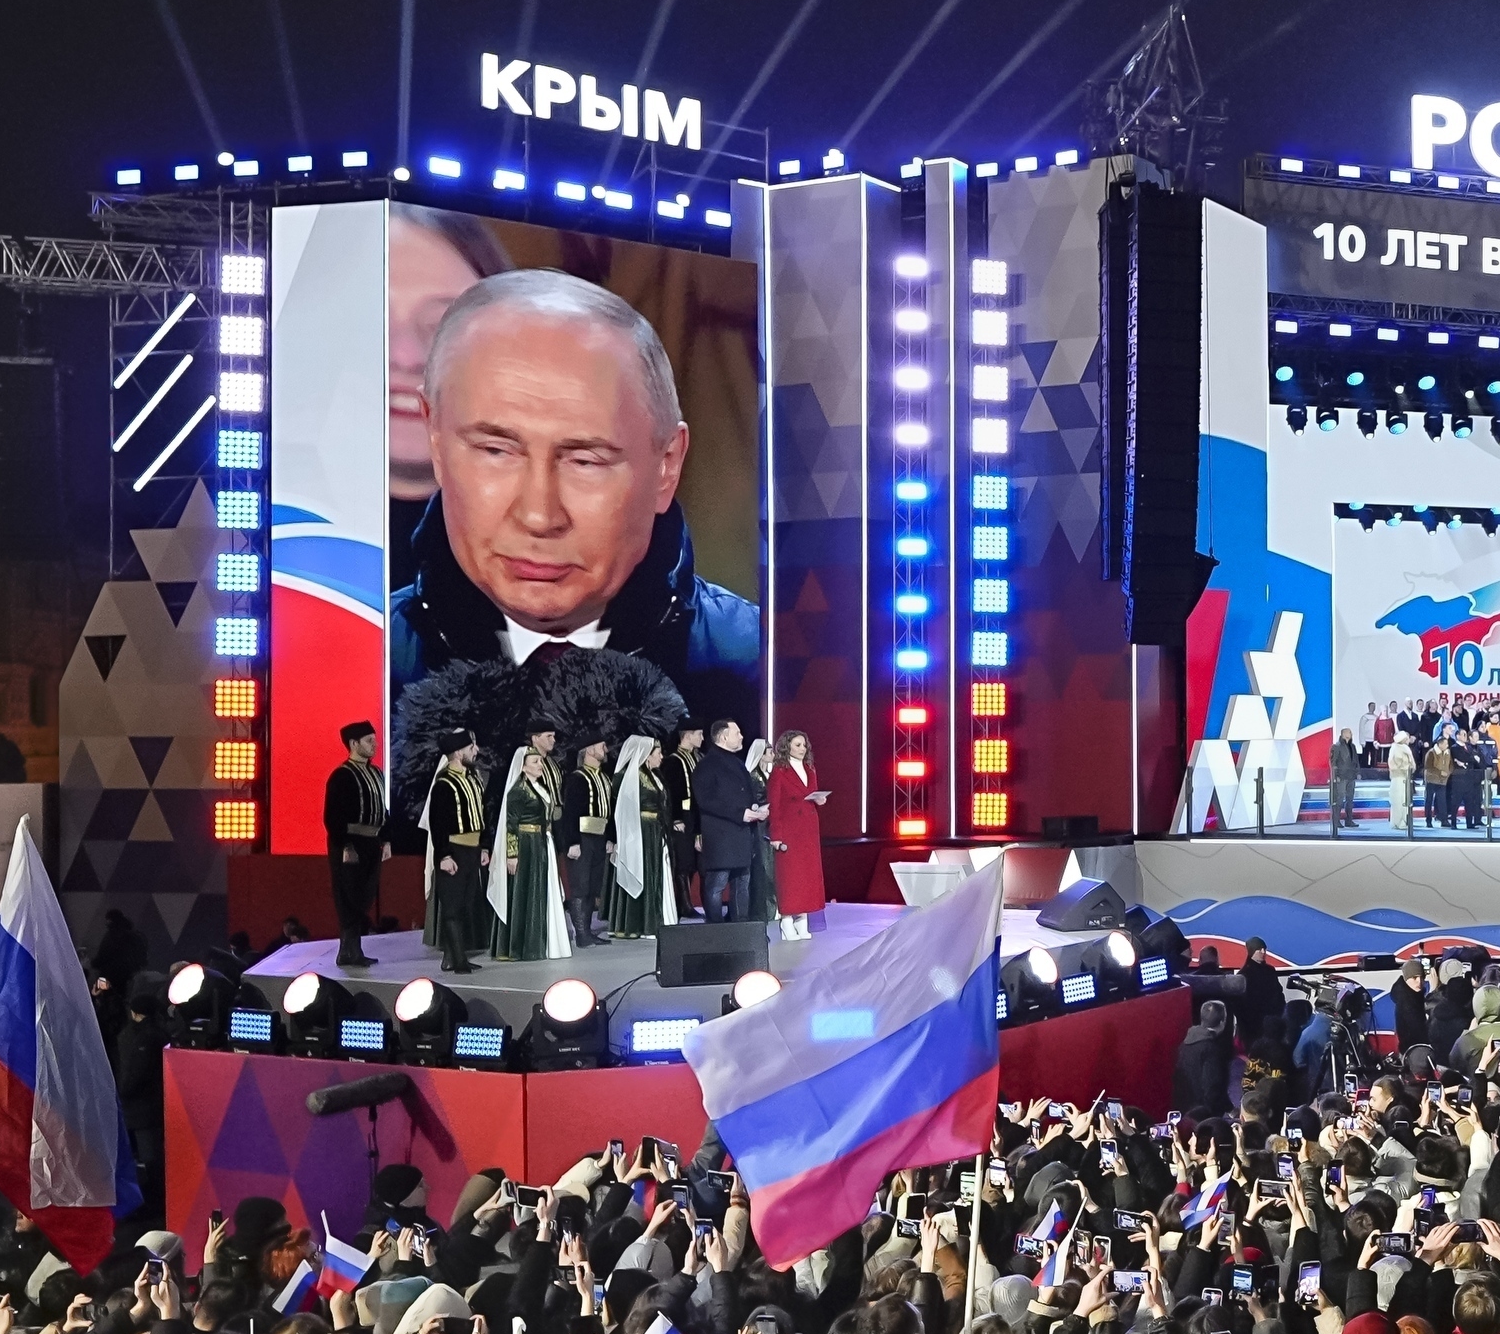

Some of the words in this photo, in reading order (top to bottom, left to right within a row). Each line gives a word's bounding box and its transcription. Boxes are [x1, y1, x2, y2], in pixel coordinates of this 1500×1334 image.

[481, 51, 702, 151] КРЫМ
[1313, 222, 1367, 264] 10
[1381, 229, 1468, 272] ЛЕТ
[1432, 642, 1483, 686] 10
